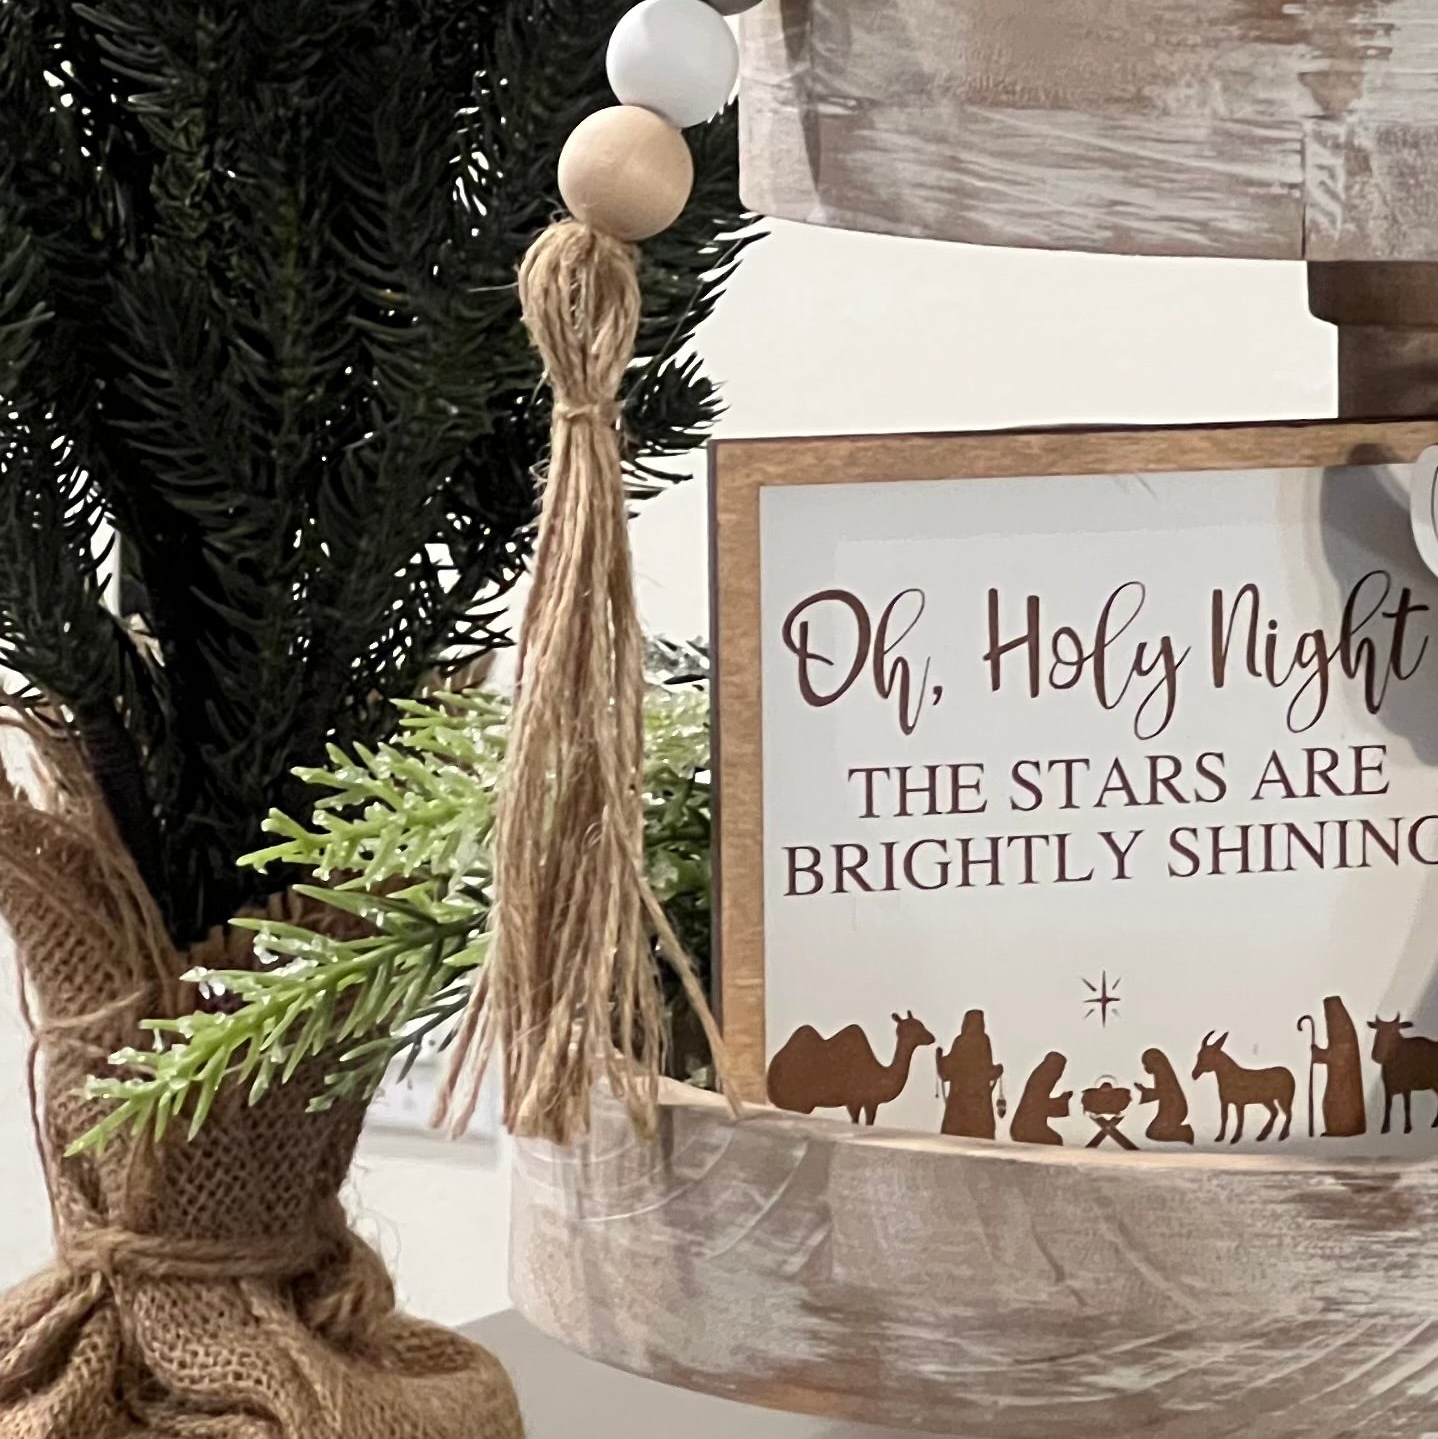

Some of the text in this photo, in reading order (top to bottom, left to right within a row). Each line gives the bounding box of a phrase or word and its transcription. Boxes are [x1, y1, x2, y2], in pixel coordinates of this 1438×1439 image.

[781, 570, 1431, 741] Oh, Holy Night
[847, 744, 1390, 819] THE STARS ARE
[782, 829, 1146, 897] BRIGHTLY
